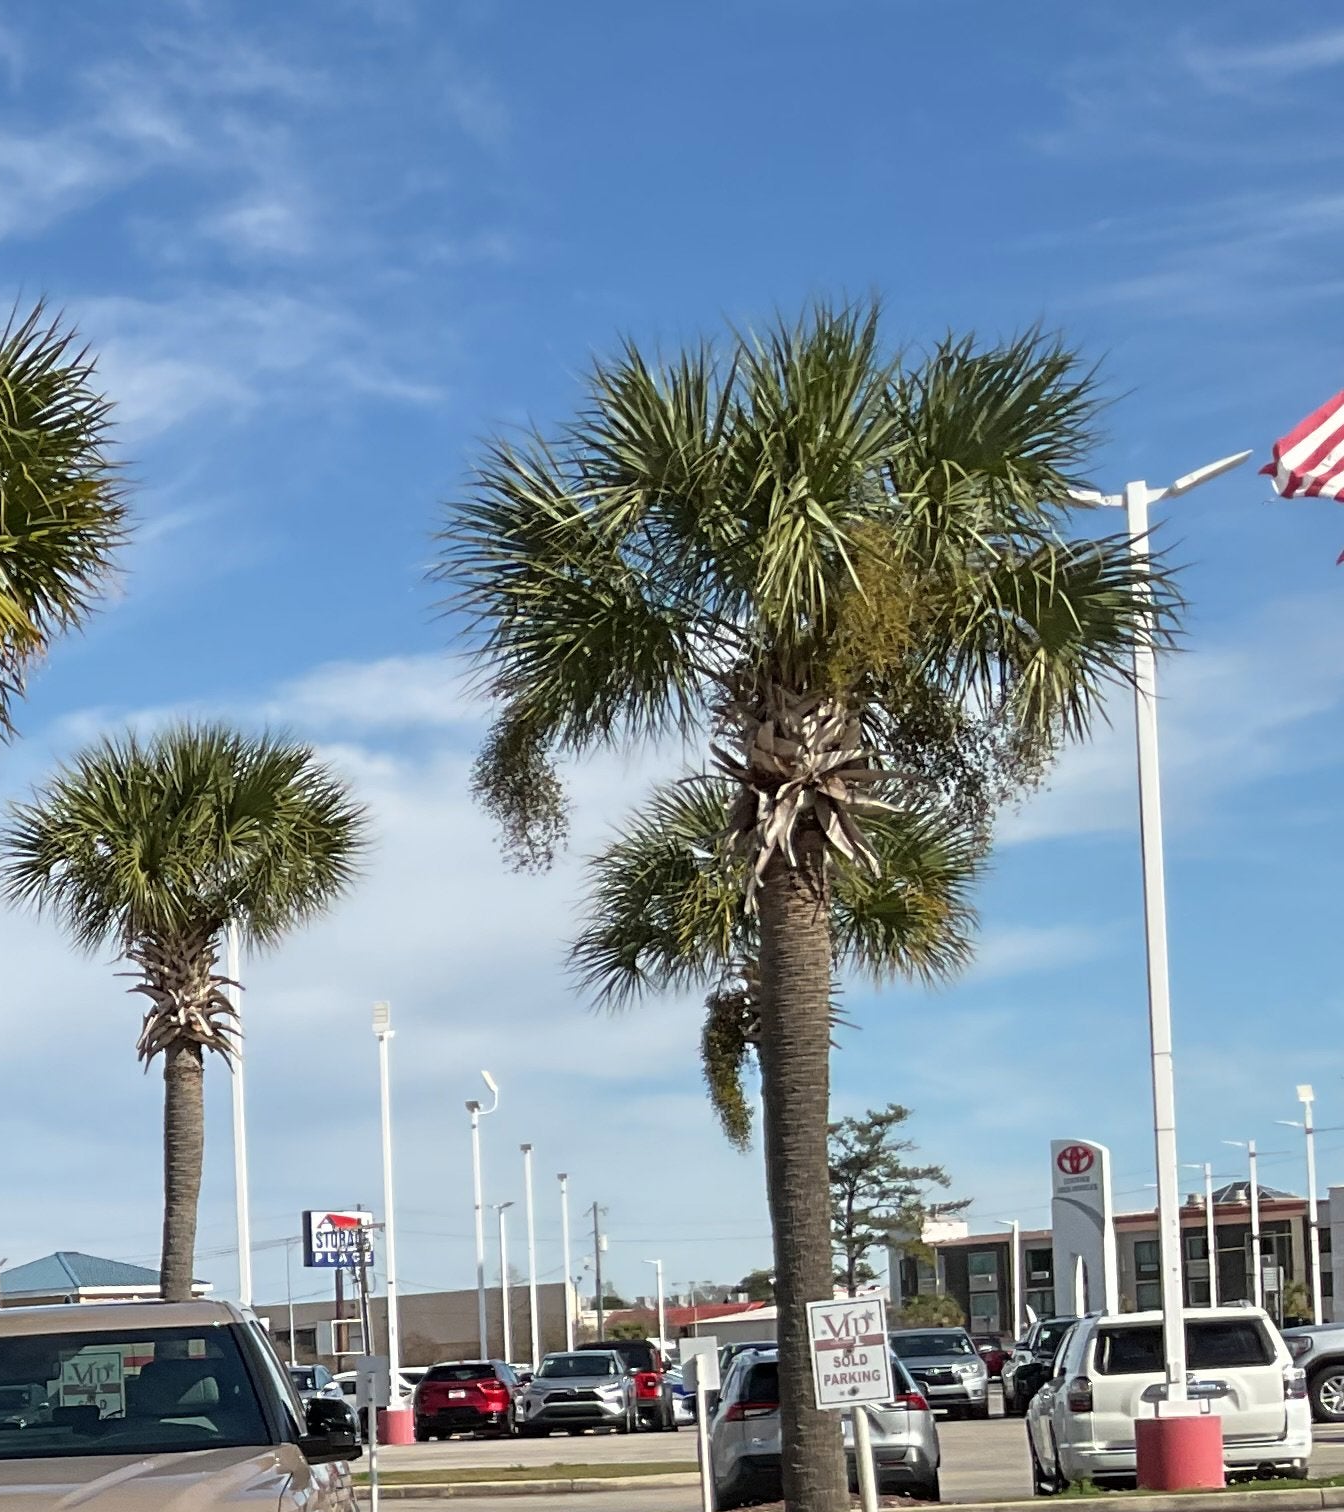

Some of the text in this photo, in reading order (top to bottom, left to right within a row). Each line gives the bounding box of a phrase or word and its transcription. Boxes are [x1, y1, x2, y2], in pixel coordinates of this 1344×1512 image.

[315, 1252, 372, 1264] PLACE
[833, 1353, 868, 1368] SOLD
[823, 1369, 881, 1387] PARKING
